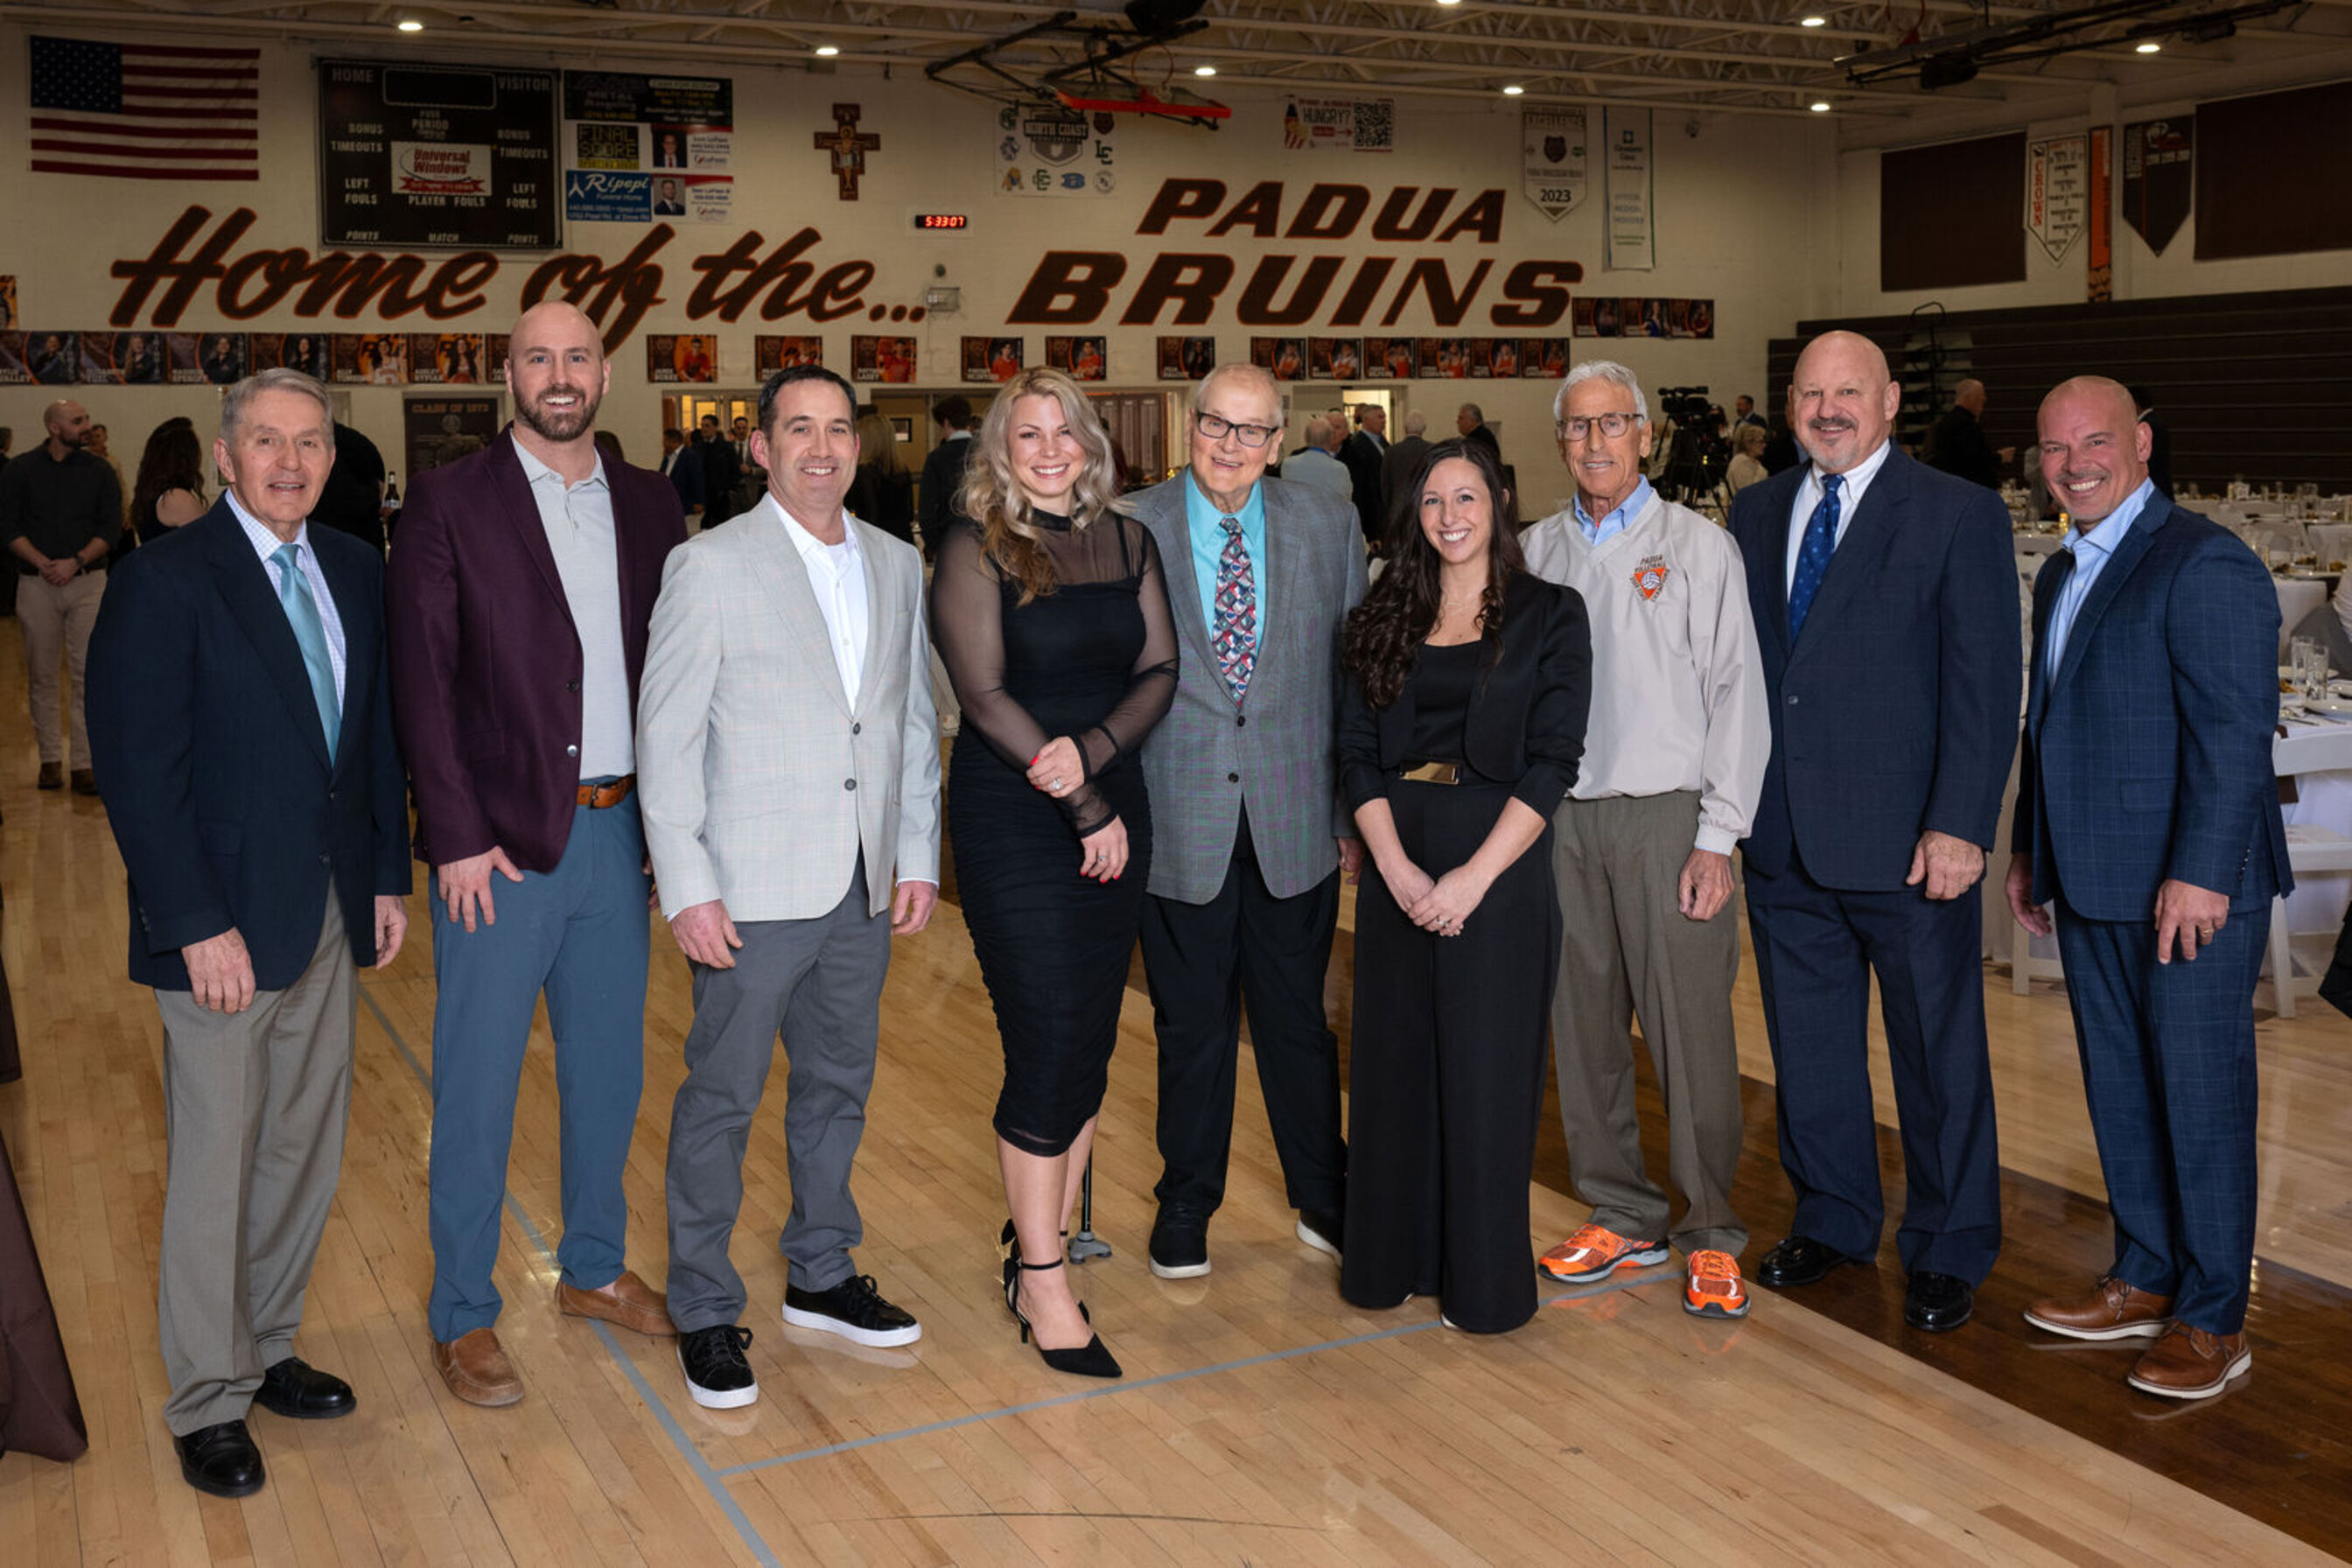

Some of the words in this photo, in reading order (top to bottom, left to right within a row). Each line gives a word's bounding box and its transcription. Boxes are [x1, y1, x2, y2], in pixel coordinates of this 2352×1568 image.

[332, 68, 374, 84] HOME
[496, 77, 550, 92] VISITOR
[1303, 108, 1352, 124] HUNGRY?
[347, 122, 383, 135] BONUS
[579, 126, 635, 142] FINAL
[497, 130, 530, 141] BONUS
[330, 141, 383, 153] TIMEOUTS
[500, 147, 549, 159] TIMEOUTS
[579, 142, 637, 158] SCORE
[414, 149, 470, 164] Universal
[413, 161, 466, 174] Windows
[345, 178, 368, 189] LEFT
[513, 183, 536, 194] LEFT
[585, 173, 649, 193] Ripepi
[345, 193, 377, 206] FOULS
[1541, 188, 1572, 202] 2023
[408, 196, 445, 207] PLAYER
[453, 197, 486, 208] FOULS
[506, 199, 537, 210] FOULS
[1135, 178, 1507, 243] PADUA
[925, 215, 965, 228] 5:33:07
[346, 231, 380, 242] POINTS
[428, 233, 459, 243] MATCH
[508, 234, 539, 245] POINTS
[108, 203, 500, 329] Home
[521, 221, 666, 357] of
[685, 225, 927, 324] the...
[1004, 249, 1584, 328] BRUINS
[1640, 554, 1663, 565] PADUA
